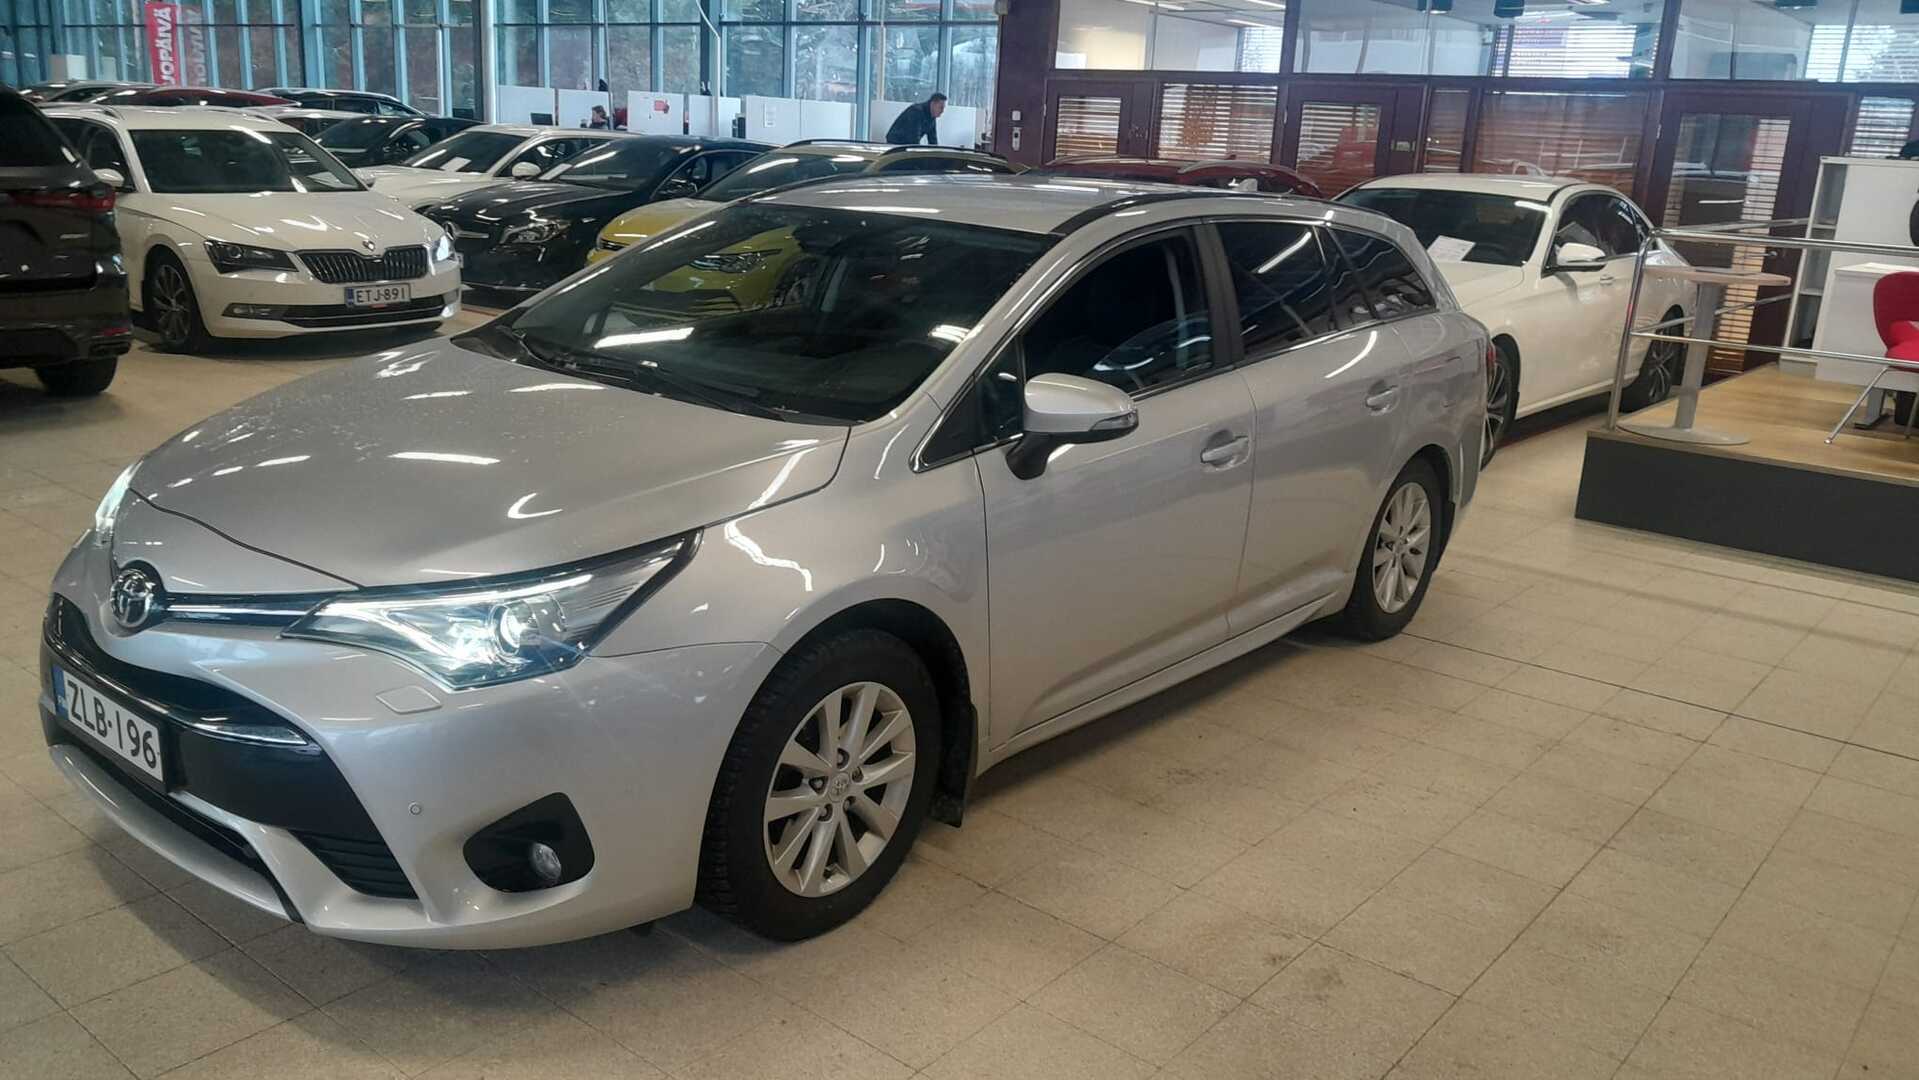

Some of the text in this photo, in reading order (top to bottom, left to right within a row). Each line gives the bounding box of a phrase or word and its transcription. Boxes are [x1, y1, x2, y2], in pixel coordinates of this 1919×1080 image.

[153, 7, 176, 86] JOPÄIVÄ
[356, 287, 405, 303] ETJ-891
[67, 680, 157, 769] ZLB-196
